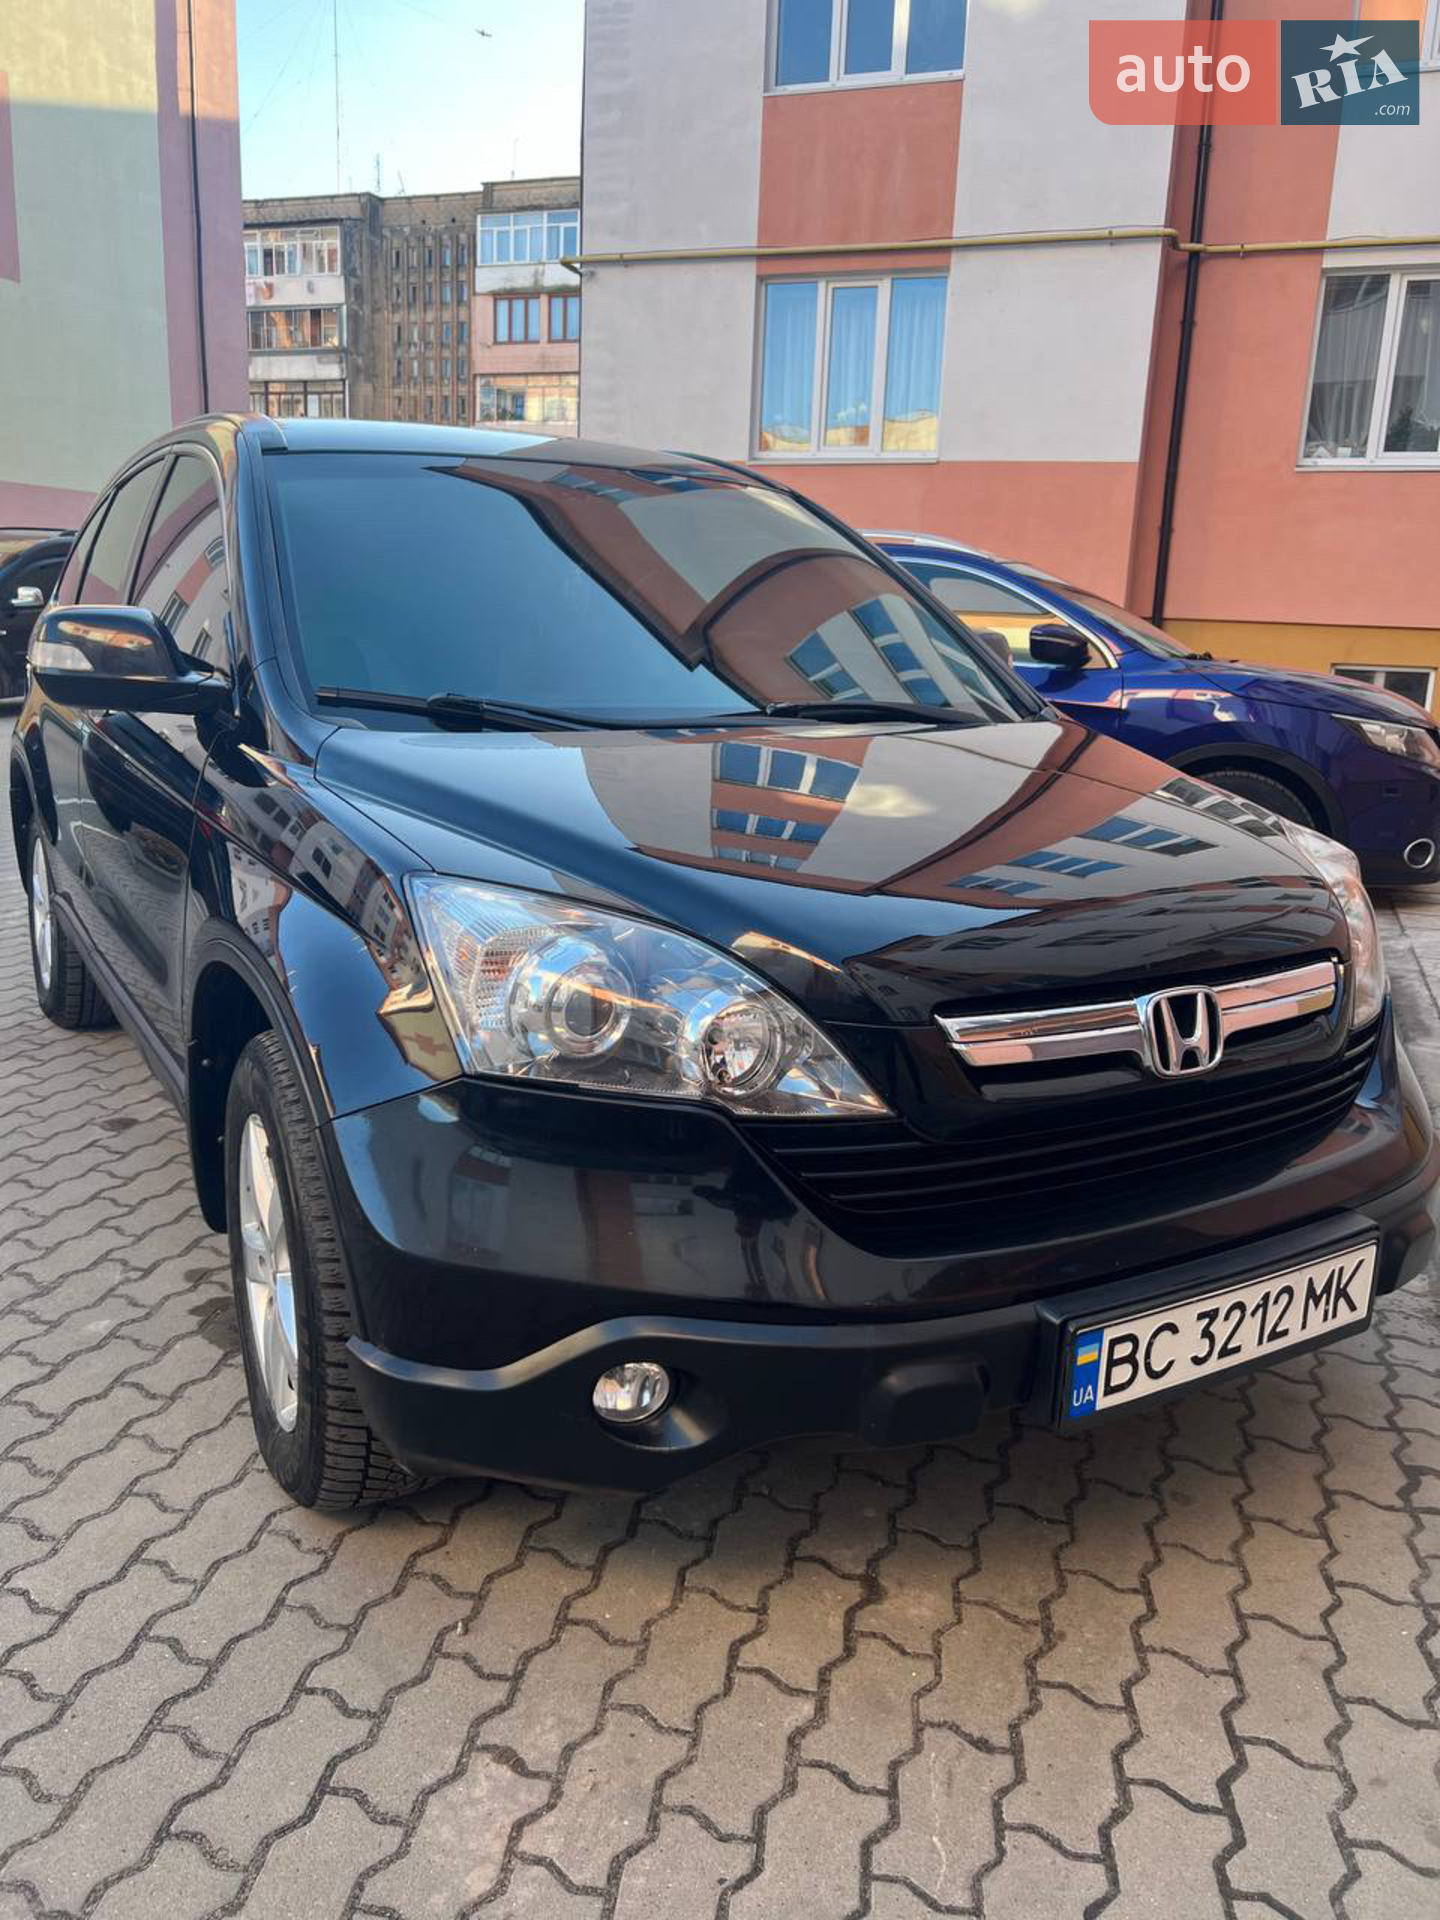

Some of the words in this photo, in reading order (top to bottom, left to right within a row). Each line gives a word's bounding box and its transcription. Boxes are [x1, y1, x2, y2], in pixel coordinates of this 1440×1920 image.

[1103, 1322, 1180, 1398] BC
[1190, 1285, 1294, 1365] 3212
[1300, 1258, 1365, 1330] MK
[1072, 1384, 1094, 1407] UA
